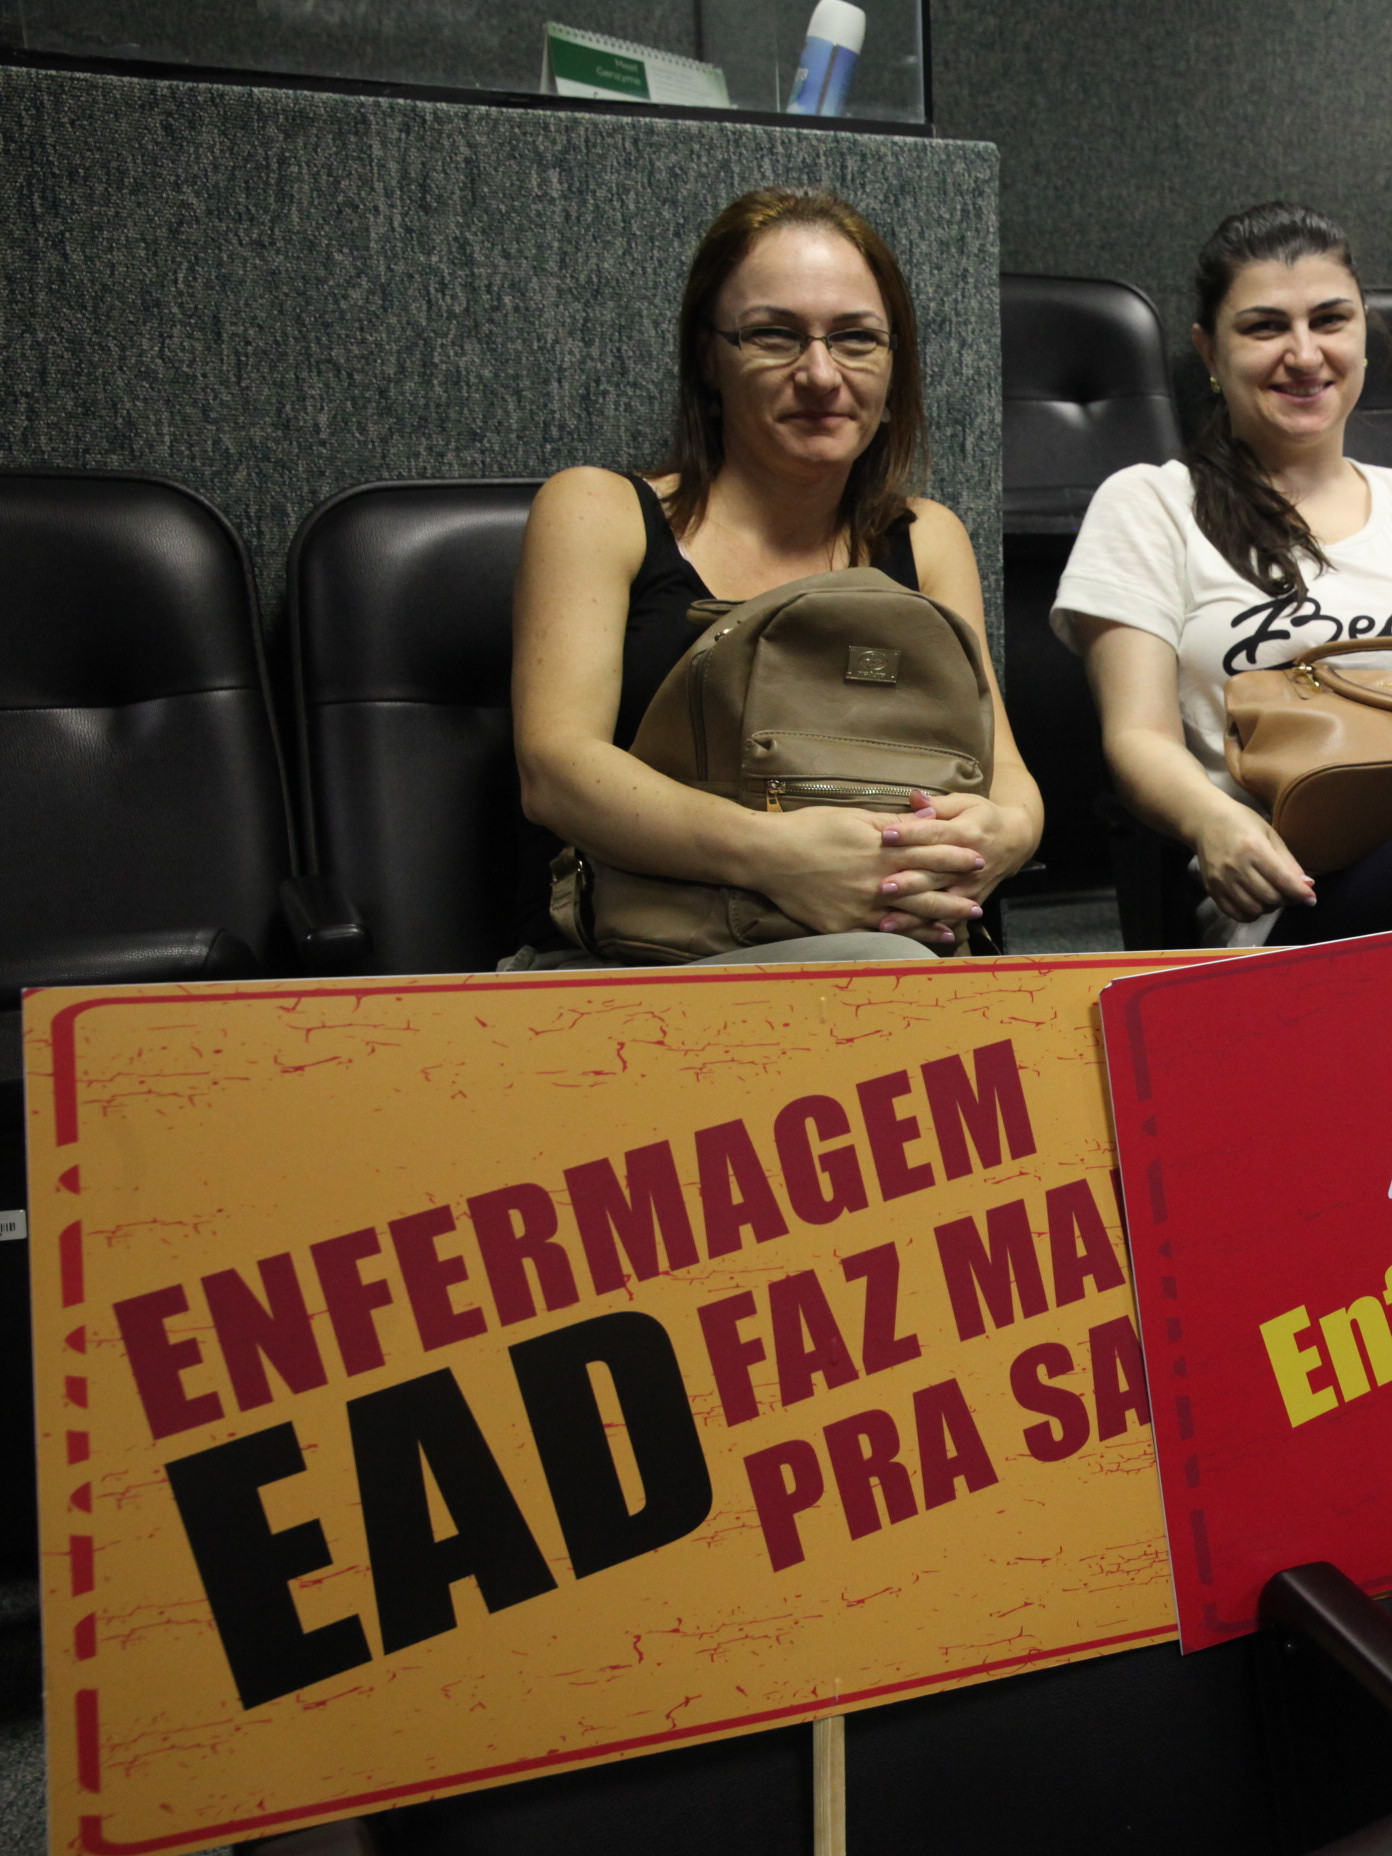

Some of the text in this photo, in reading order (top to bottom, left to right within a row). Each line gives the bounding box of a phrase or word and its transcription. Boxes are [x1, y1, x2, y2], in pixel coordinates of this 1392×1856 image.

[112, 1038, 1038, 1441] ENFERMAGEM
[697, 1167, 1127, 1428] FAZ MA
[164, 1310, 714, 1712] EAD
[743, 1377, 999, 1572] PRA
